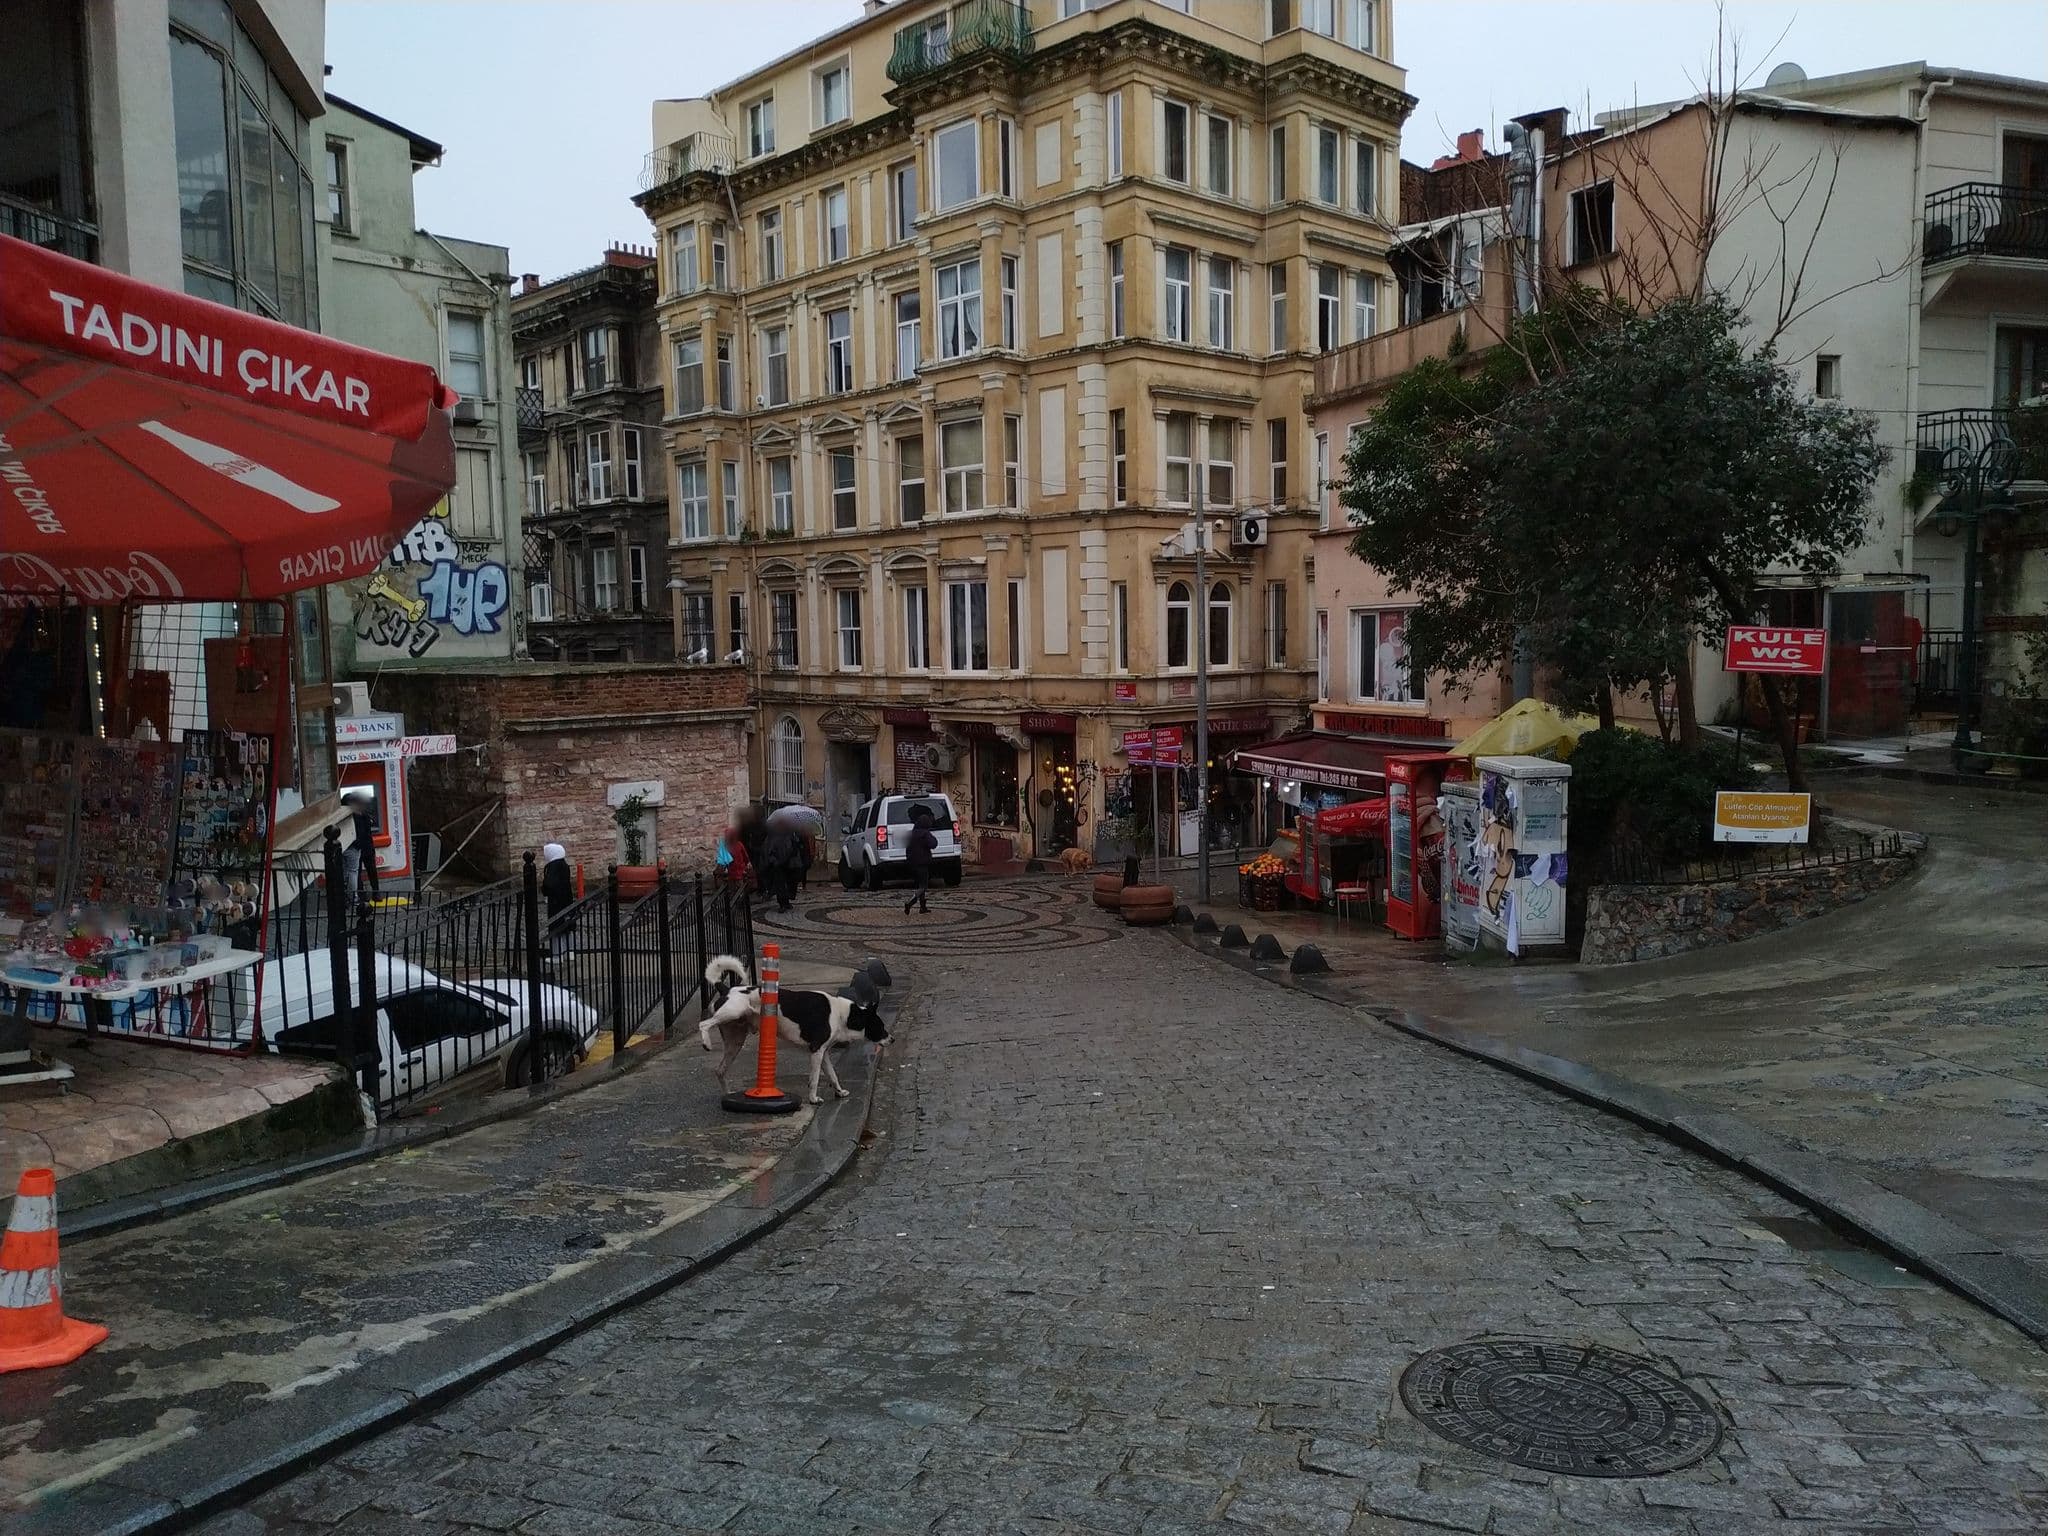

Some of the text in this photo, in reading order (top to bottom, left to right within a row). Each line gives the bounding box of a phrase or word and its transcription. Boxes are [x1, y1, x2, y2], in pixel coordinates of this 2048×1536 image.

[49, 290, 371, 416] TADINI ÇIKAR
[1733, 630, 1824, 646] KULE
[1750, 646, 1802, 660] WC
[361, 722, 394, 733] BANK
[1027, 717, 1057, 728] SHOP
[340, 751, 397, 762] ING BANK
